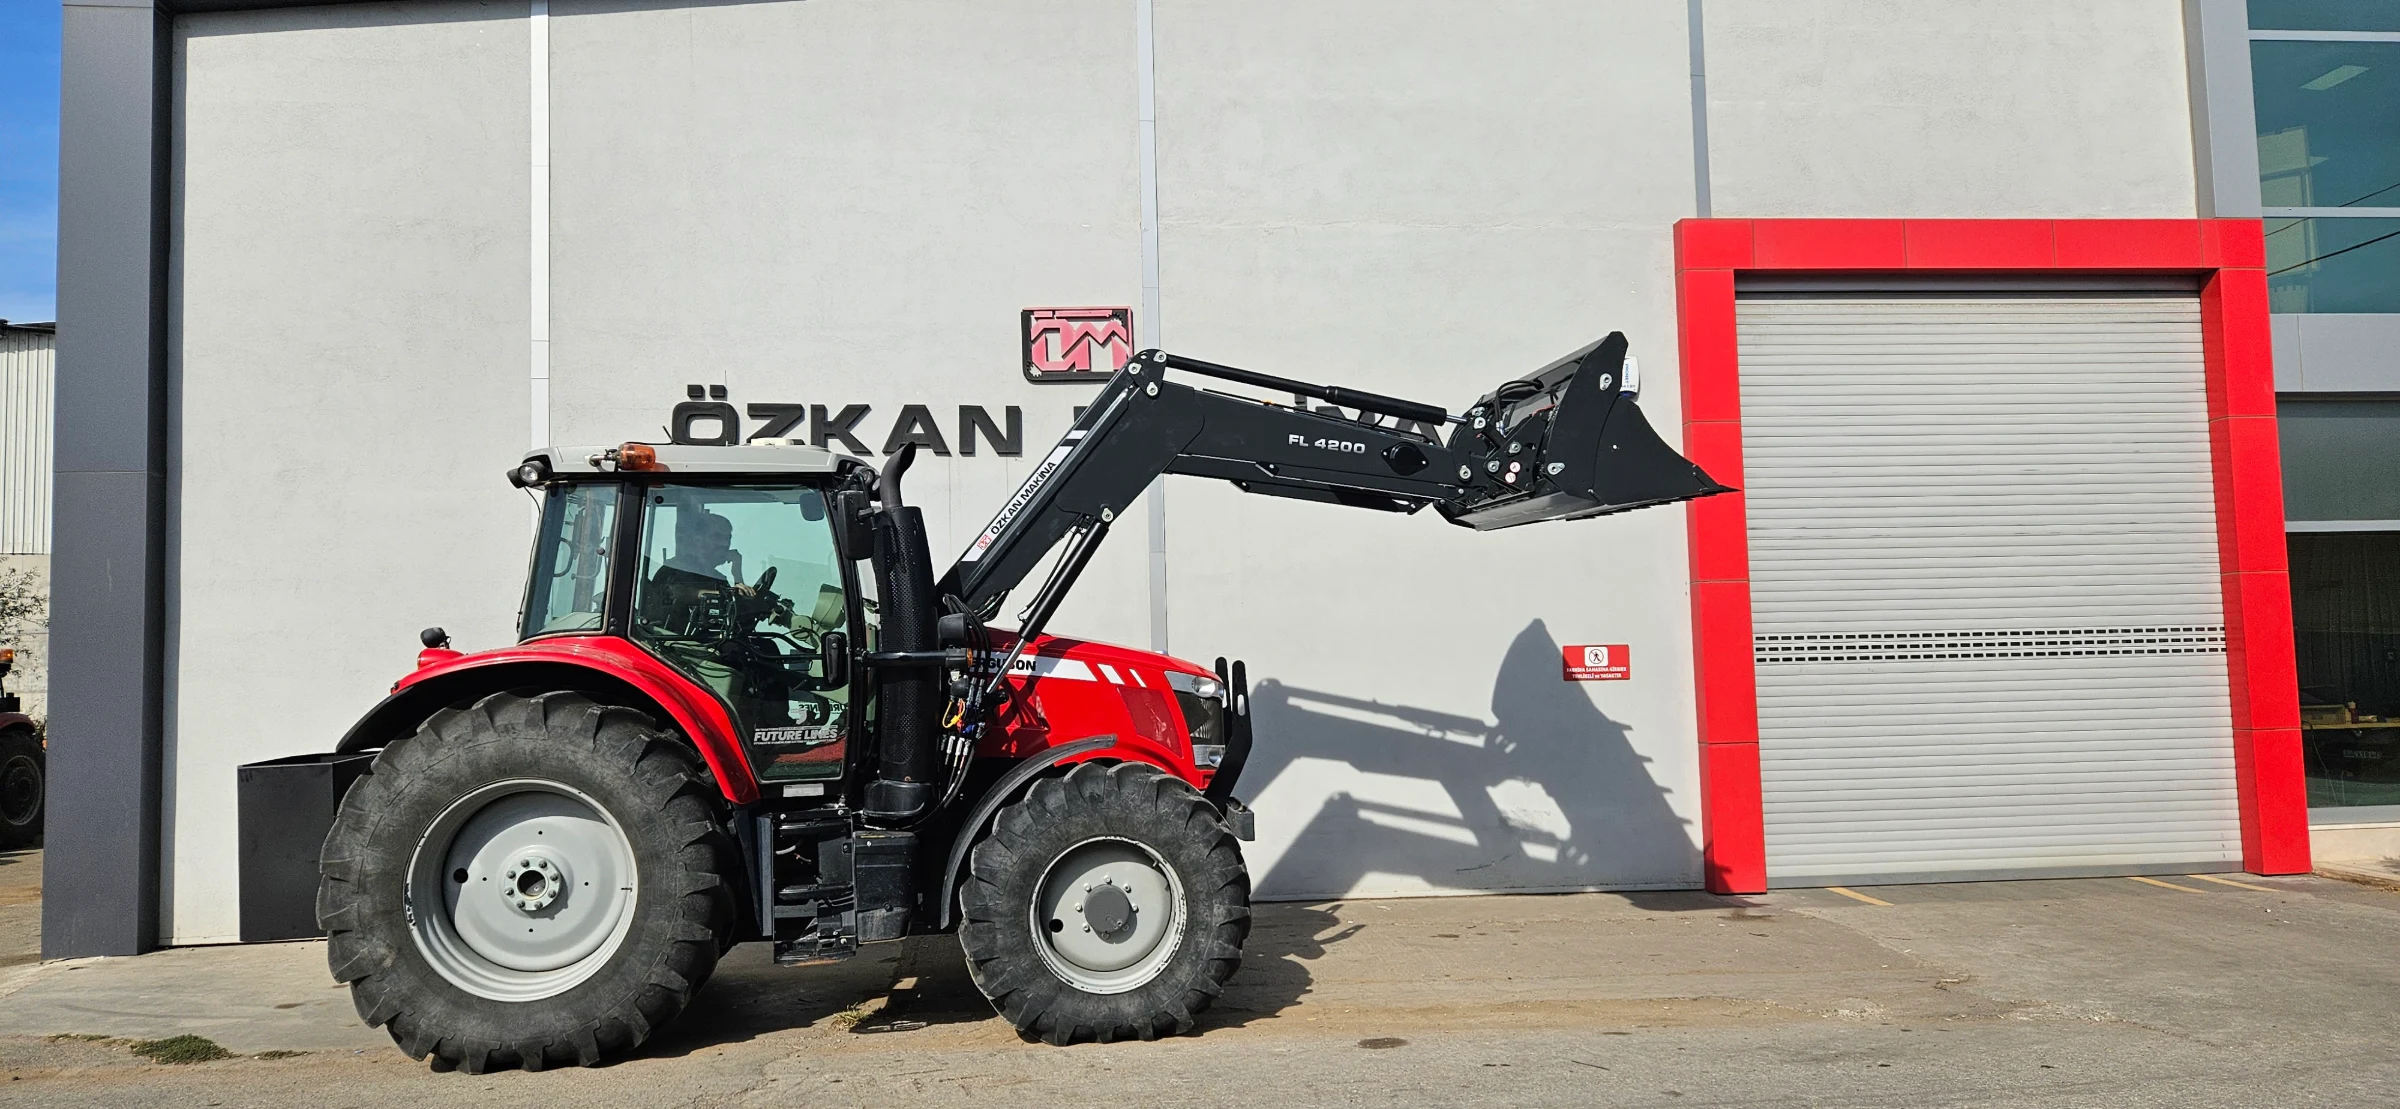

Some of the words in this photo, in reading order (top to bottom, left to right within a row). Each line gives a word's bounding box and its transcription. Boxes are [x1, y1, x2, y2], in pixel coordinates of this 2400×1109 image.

[671, 384, 1022, 458] ÖZKAN
[1288, 434, 1308, 447] FL
[1314, 438, 1366, 454] 4200
[990, 499, 1022, 535] ÖZKAN
[1020, 461, 1056, 502] MAKİNA
[754, 730, 803, 742] FUTURE
[803, 729, 839, 740] LINES
